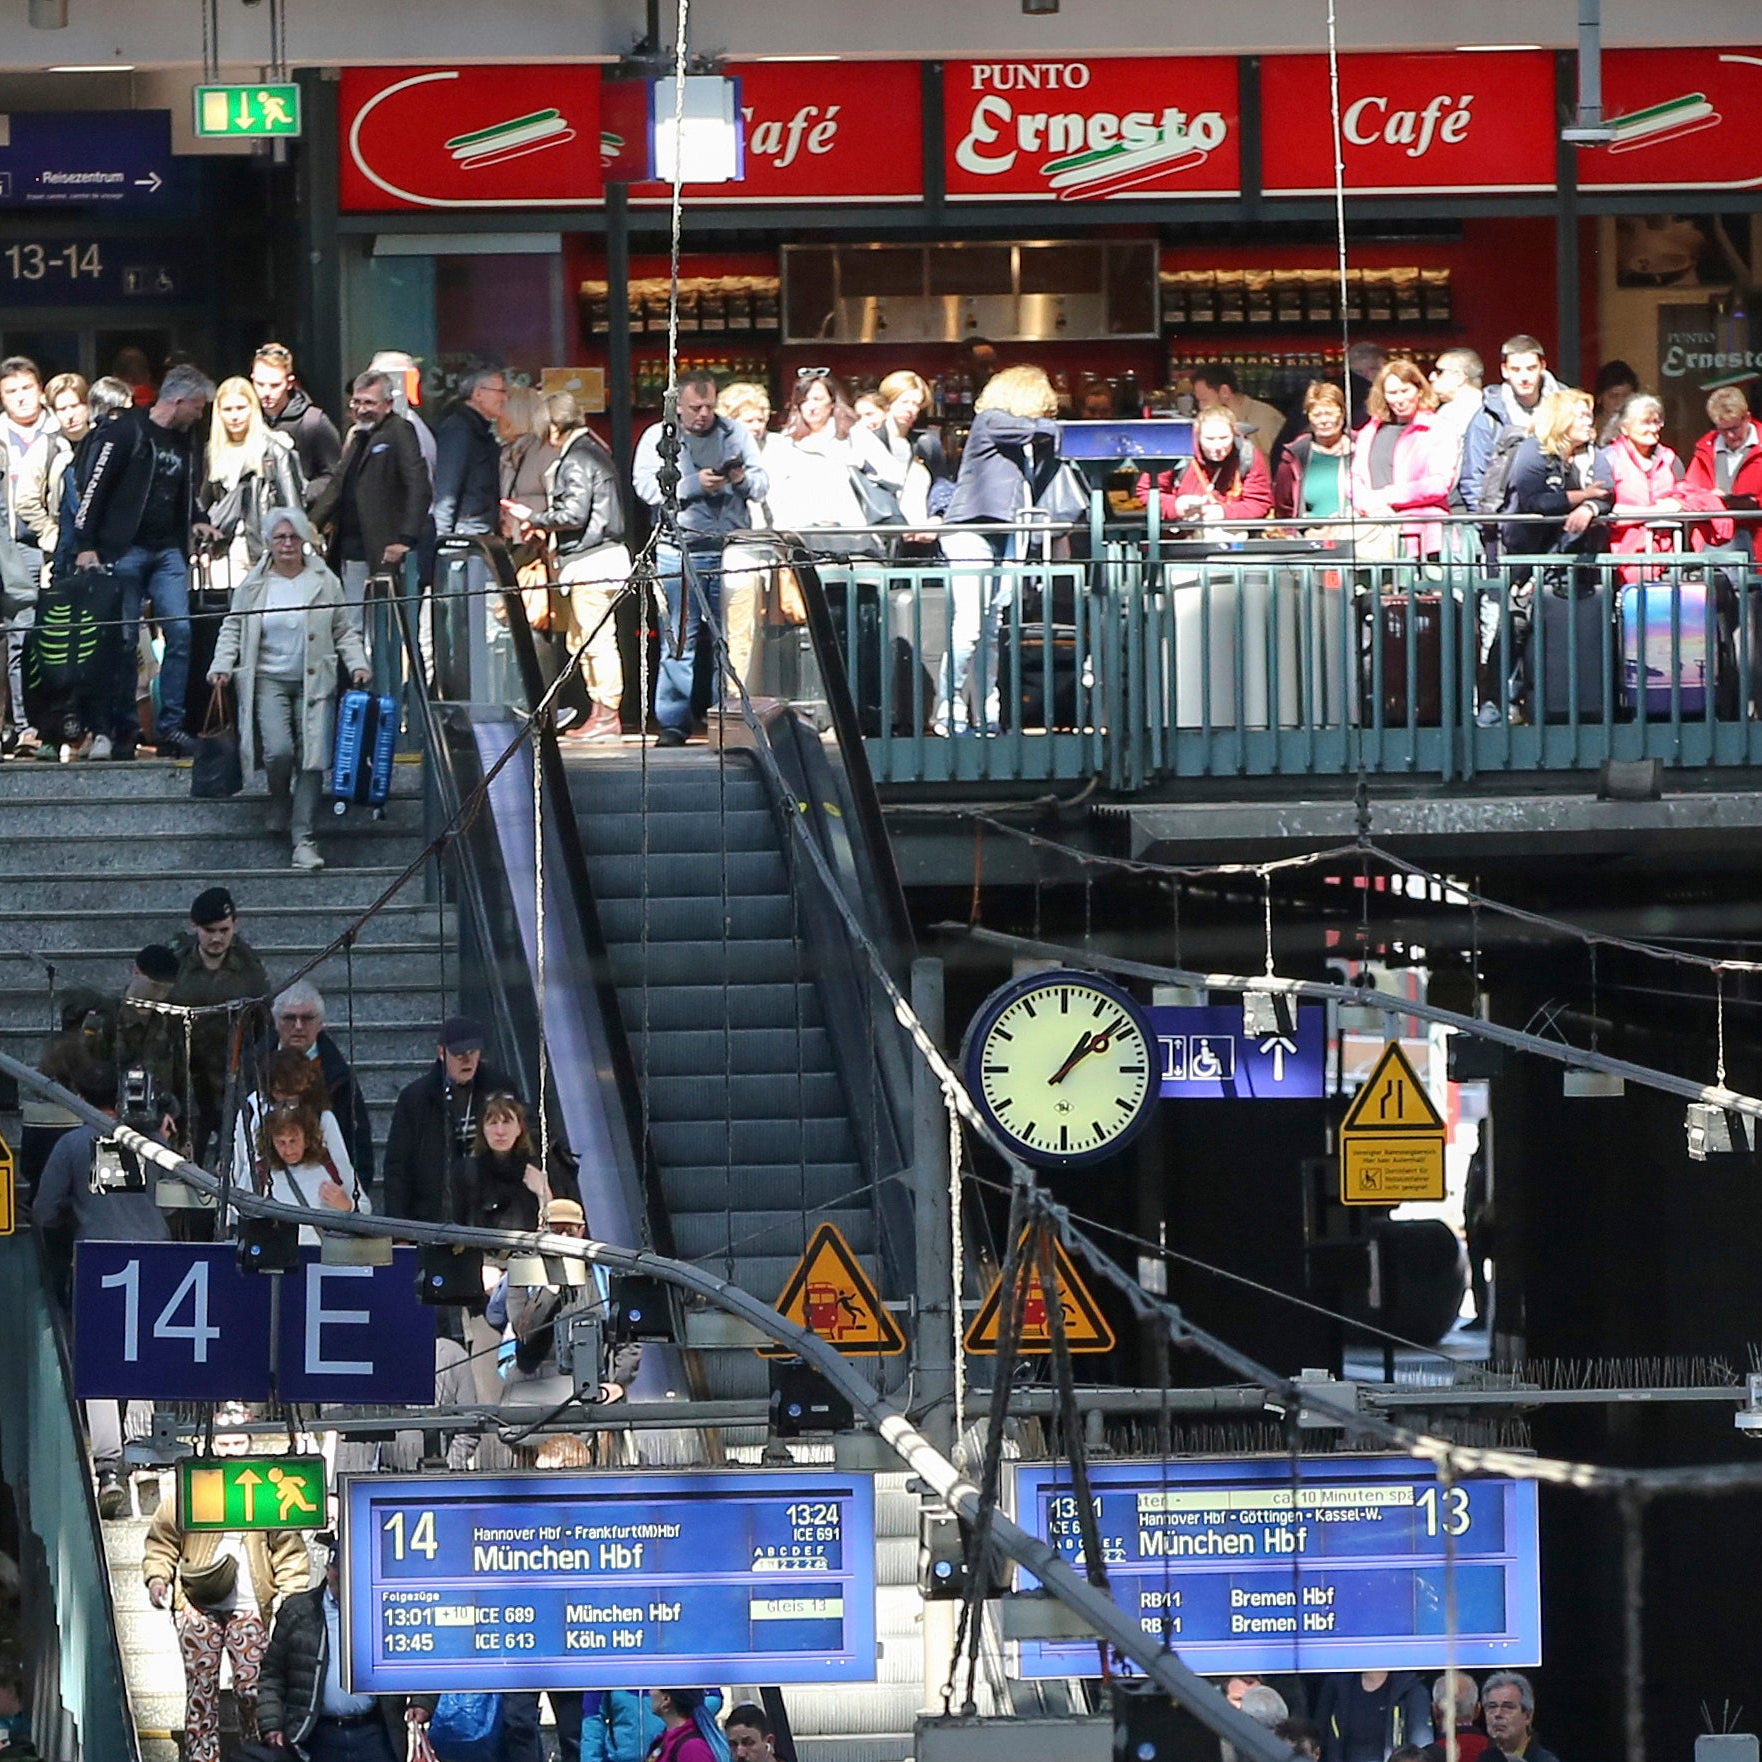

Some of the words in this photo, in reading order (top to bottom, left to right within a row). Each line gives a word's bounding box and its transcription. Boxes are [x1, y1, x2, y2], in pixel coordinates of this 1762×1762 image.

[973, 64, 1090, 90] PUNTO
[741, 106, 841, 168] afé
[955, 94, 1229, 174] Ernesto
[1344, 95, 1475, 158] Café
[42, 171, 124, 184] Reisezentrum
[5, 244, 103, 280] 13-14
[1667, 332, 1716, 344] PUNTO
[101, 1259, 221, 1364] 14
[305, 1264, 375, 1375] E
[1051, 1497, 1102, 1518] 13:1
[1322, 1488, 1389, 1503] Minuten
[786, 1504, 839, 1525] 13:24
[1139, 1512, 1198, 1527] Hannover
[1204, 1511, 1226, 1526] Hbf
[1240, 1509, 1303, 1527] Göttingen
[1316, 1507, 1382, 1523] Kassel-W.
[1416, 1486, 1471, 1537] 13
[383, 1511, 438, 1560] 14
[474, 1526, 536, 1541] Hannover
[539, 1525, 562, 1541] Hbf
[575, 1523, 682, 1541] Frankfurt(M)Hbf
[794, 1528, 813, 1541] ICE
[816, 1527, 840, 1541] 691
[1139, 1529, 1254, 1557] München
[1264, 1527, 1307, 1553] Hbf
[474, 1545, 593, 1572] München
[600, 1543, 644, 1570] Hbf
[382, 1590, 440, 1604] Folgezüge
[1230, 1589, 1297, 1608] Bremen
[1303, 1588, 1336, 1606] Hbf
[383, 1608, 433, 1626] 13:01
[475, 1607, 499, 1624] ICE
[505, 1606, 535, 1624] 689
[566, 1604, 643, 1623] München
[650, 1602, 681, 1622] Hbf
[767, 1599, 804, 1613] Gleis
[1230, 1615, 1297, 1633] Bremen
[1303, 1613, 1336, 1631] Hbf
[383, 1634, 434, 1652] 13:45
[475, 1632, 499, 1650] ICE
[505, 1632, 535, 1650] 613
[566, 1629, 606, 1649] Köln
[611, 1628, 643, 1648] Hbf
